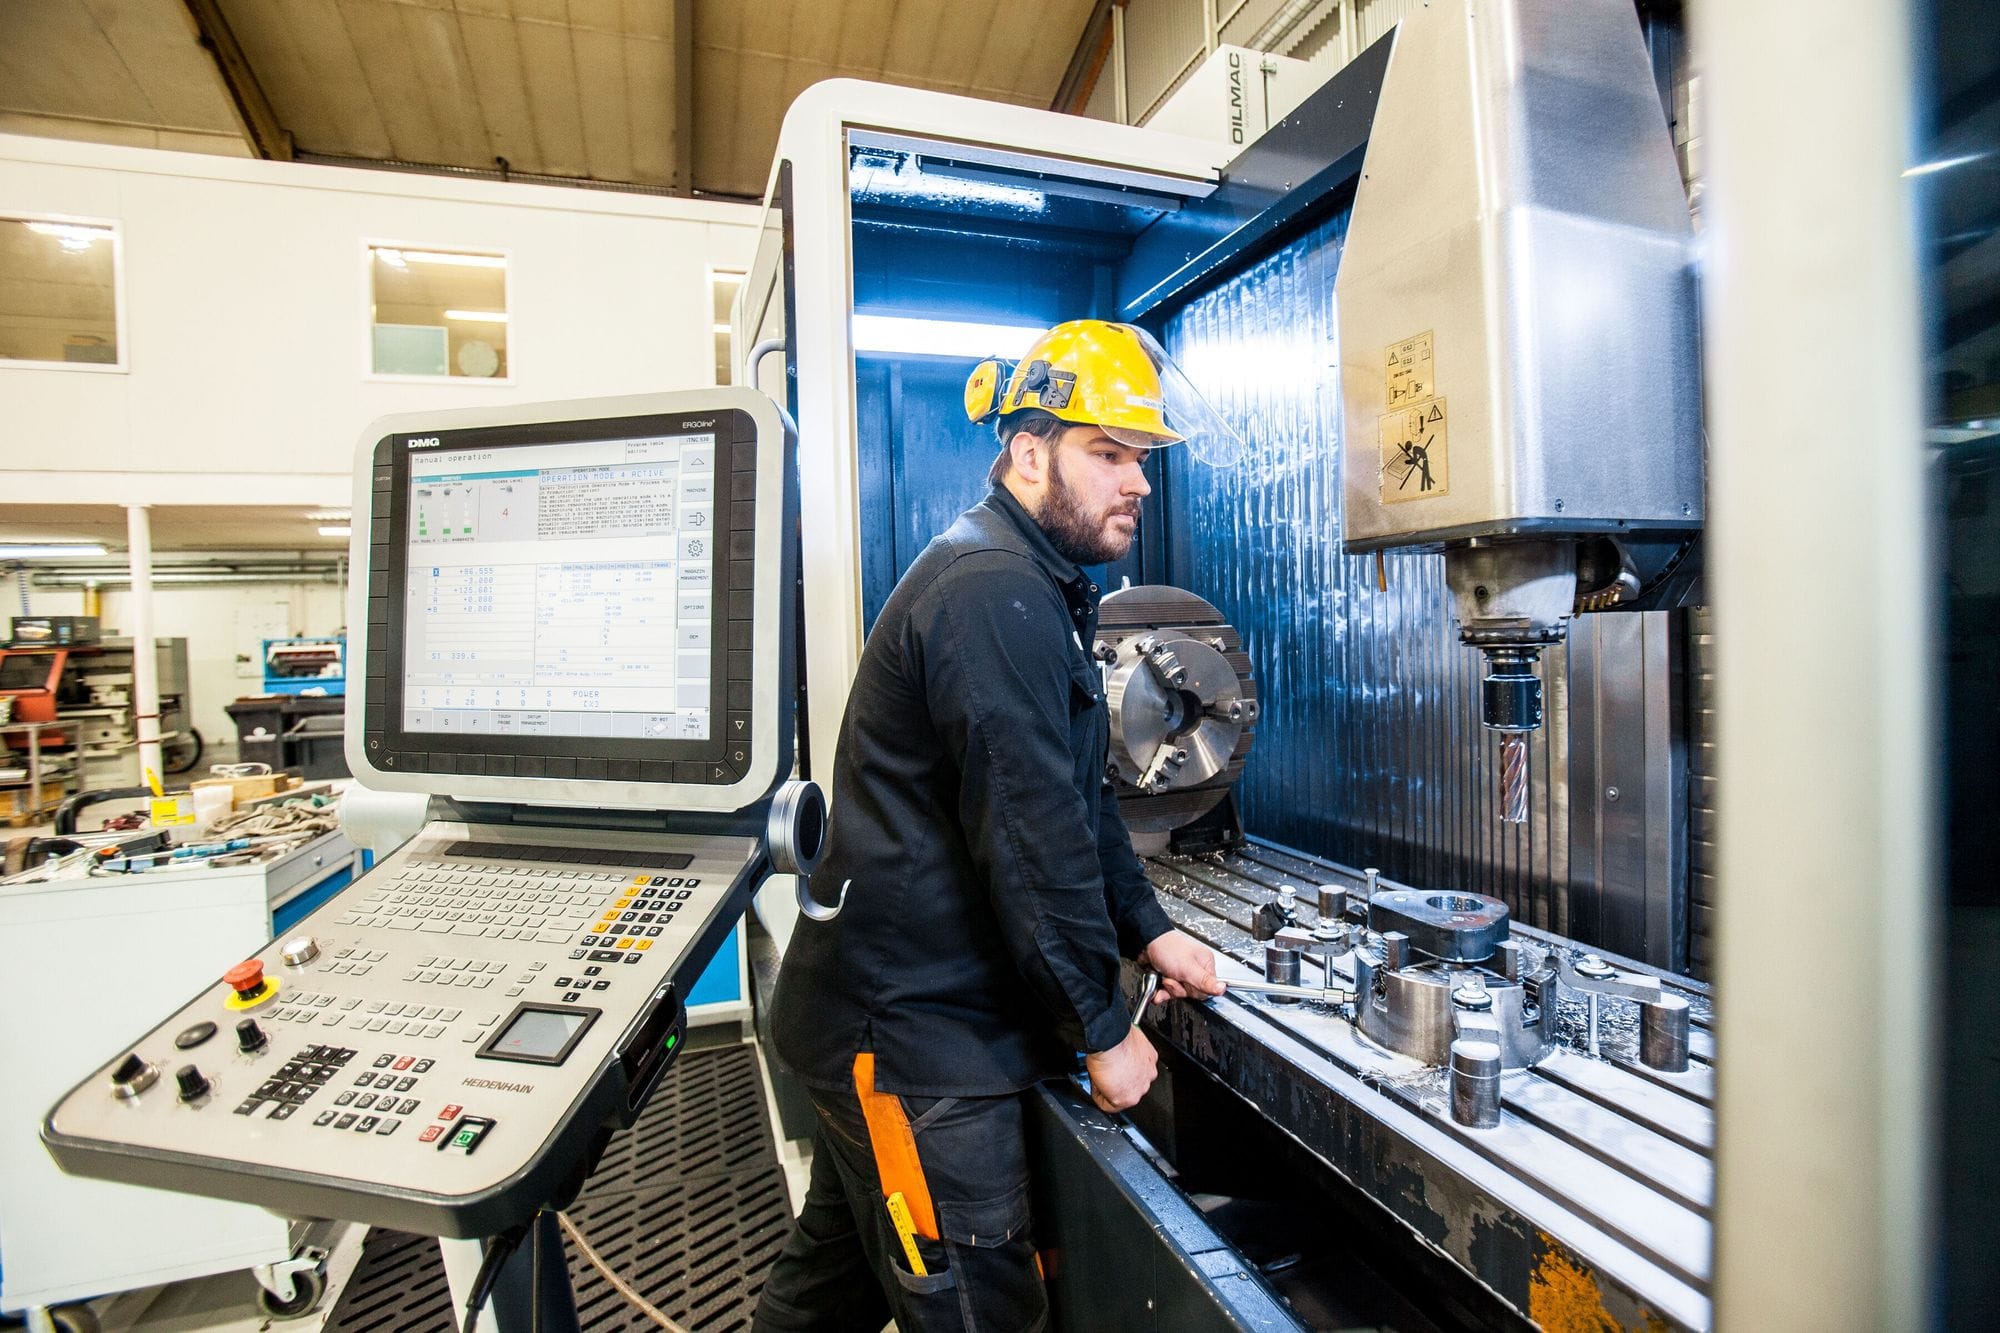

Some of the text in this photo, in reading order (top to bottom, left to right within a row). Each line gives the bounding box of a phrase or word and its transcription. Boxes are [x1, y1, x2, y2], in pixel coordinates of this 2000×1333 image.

[1229, 52, 1243, 144] OILMAC
[408, 438, 440, 448] DMG
[415, 453, 492, 464] Manual operation
[541, 474, 588, 483] OPERATION
[594, 472, 615, 480] MODE
[632, 469, 665, 477] ACTIVE
[502, 508, 509, 517] 4
[573, 690, 599, 698] POWER
[444, 718, 449, 726] S
[461, 1077, 535, 1094] HEIDENHAIN
